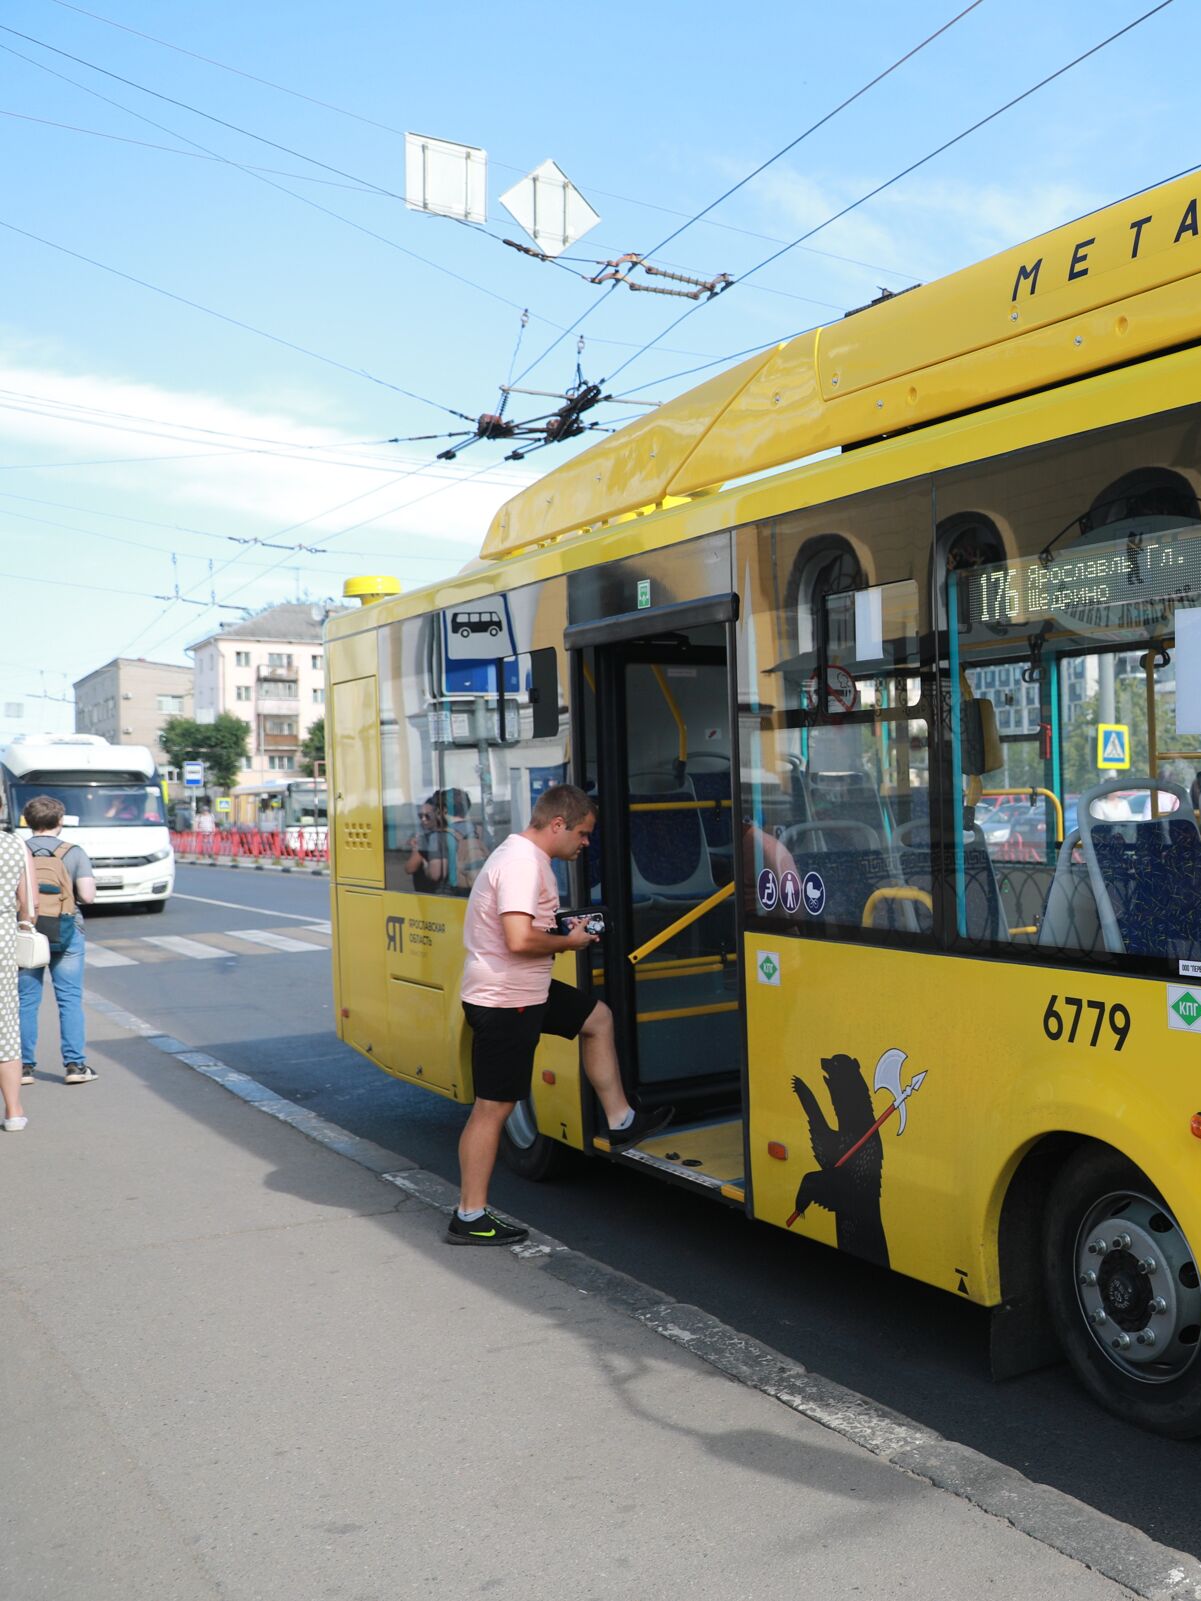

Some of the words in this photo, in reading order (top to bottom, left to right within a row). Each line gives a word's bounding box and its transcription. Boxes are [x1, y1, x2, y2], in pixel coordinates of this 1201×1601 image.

[1028, 556, 1133, 588] Ярославль
[1147, 544, 1184, 568] Гл.
[979, 569, 1019, 621] 176
[1043, 994, 1131, 1052] 6779
[1179, 1001, 1199, 1017] КПГ
